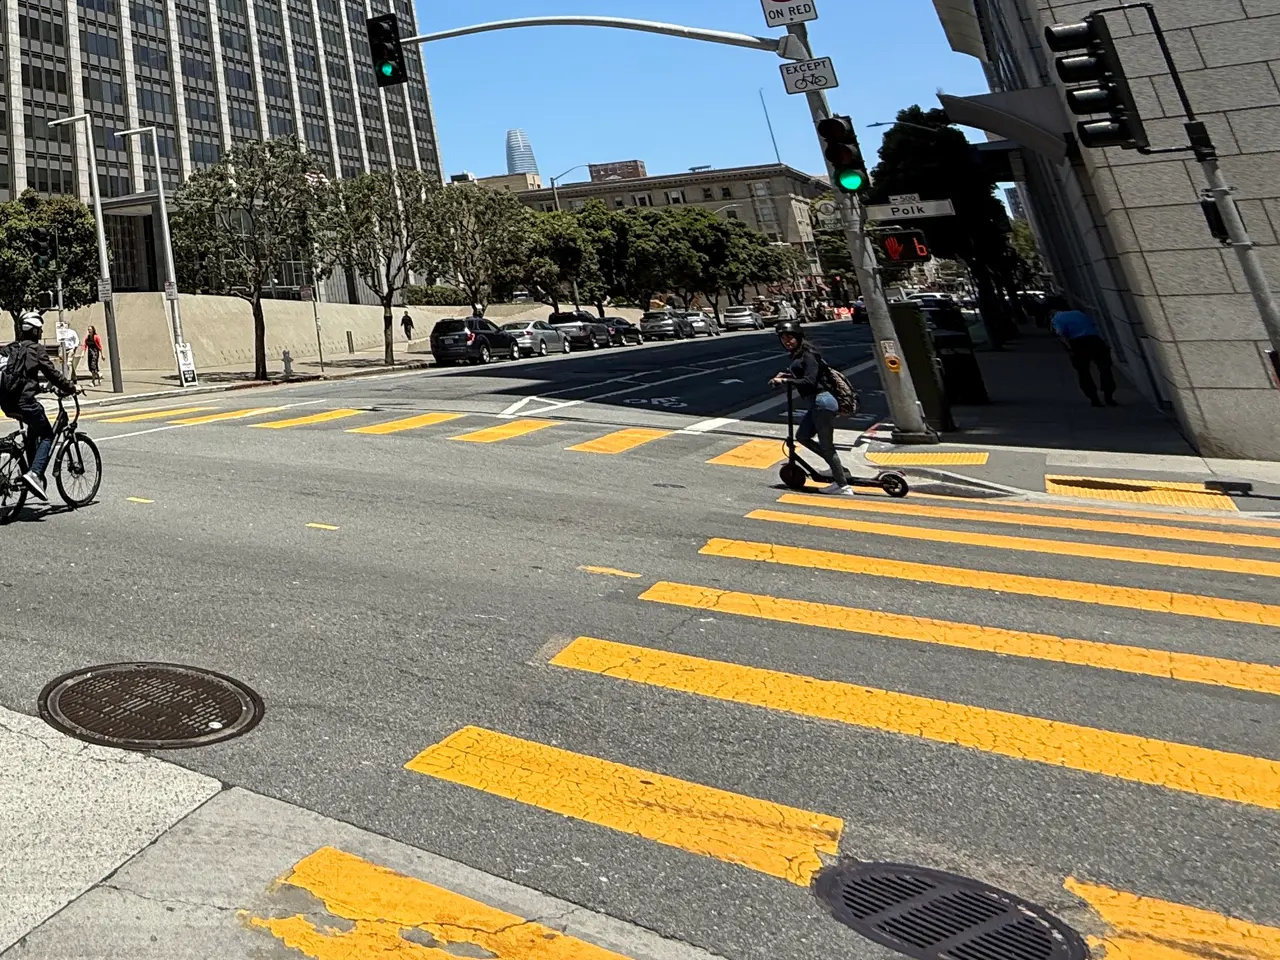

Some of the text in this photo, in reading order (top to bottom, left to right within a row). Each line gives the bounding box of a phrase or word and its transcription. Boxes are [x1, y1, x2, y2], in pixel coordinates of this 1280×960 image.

[768, 3, 811, 20] ON RED
[785, 60, 827, 75] EXCEPT
[891, 206, 926, 216] Polk
